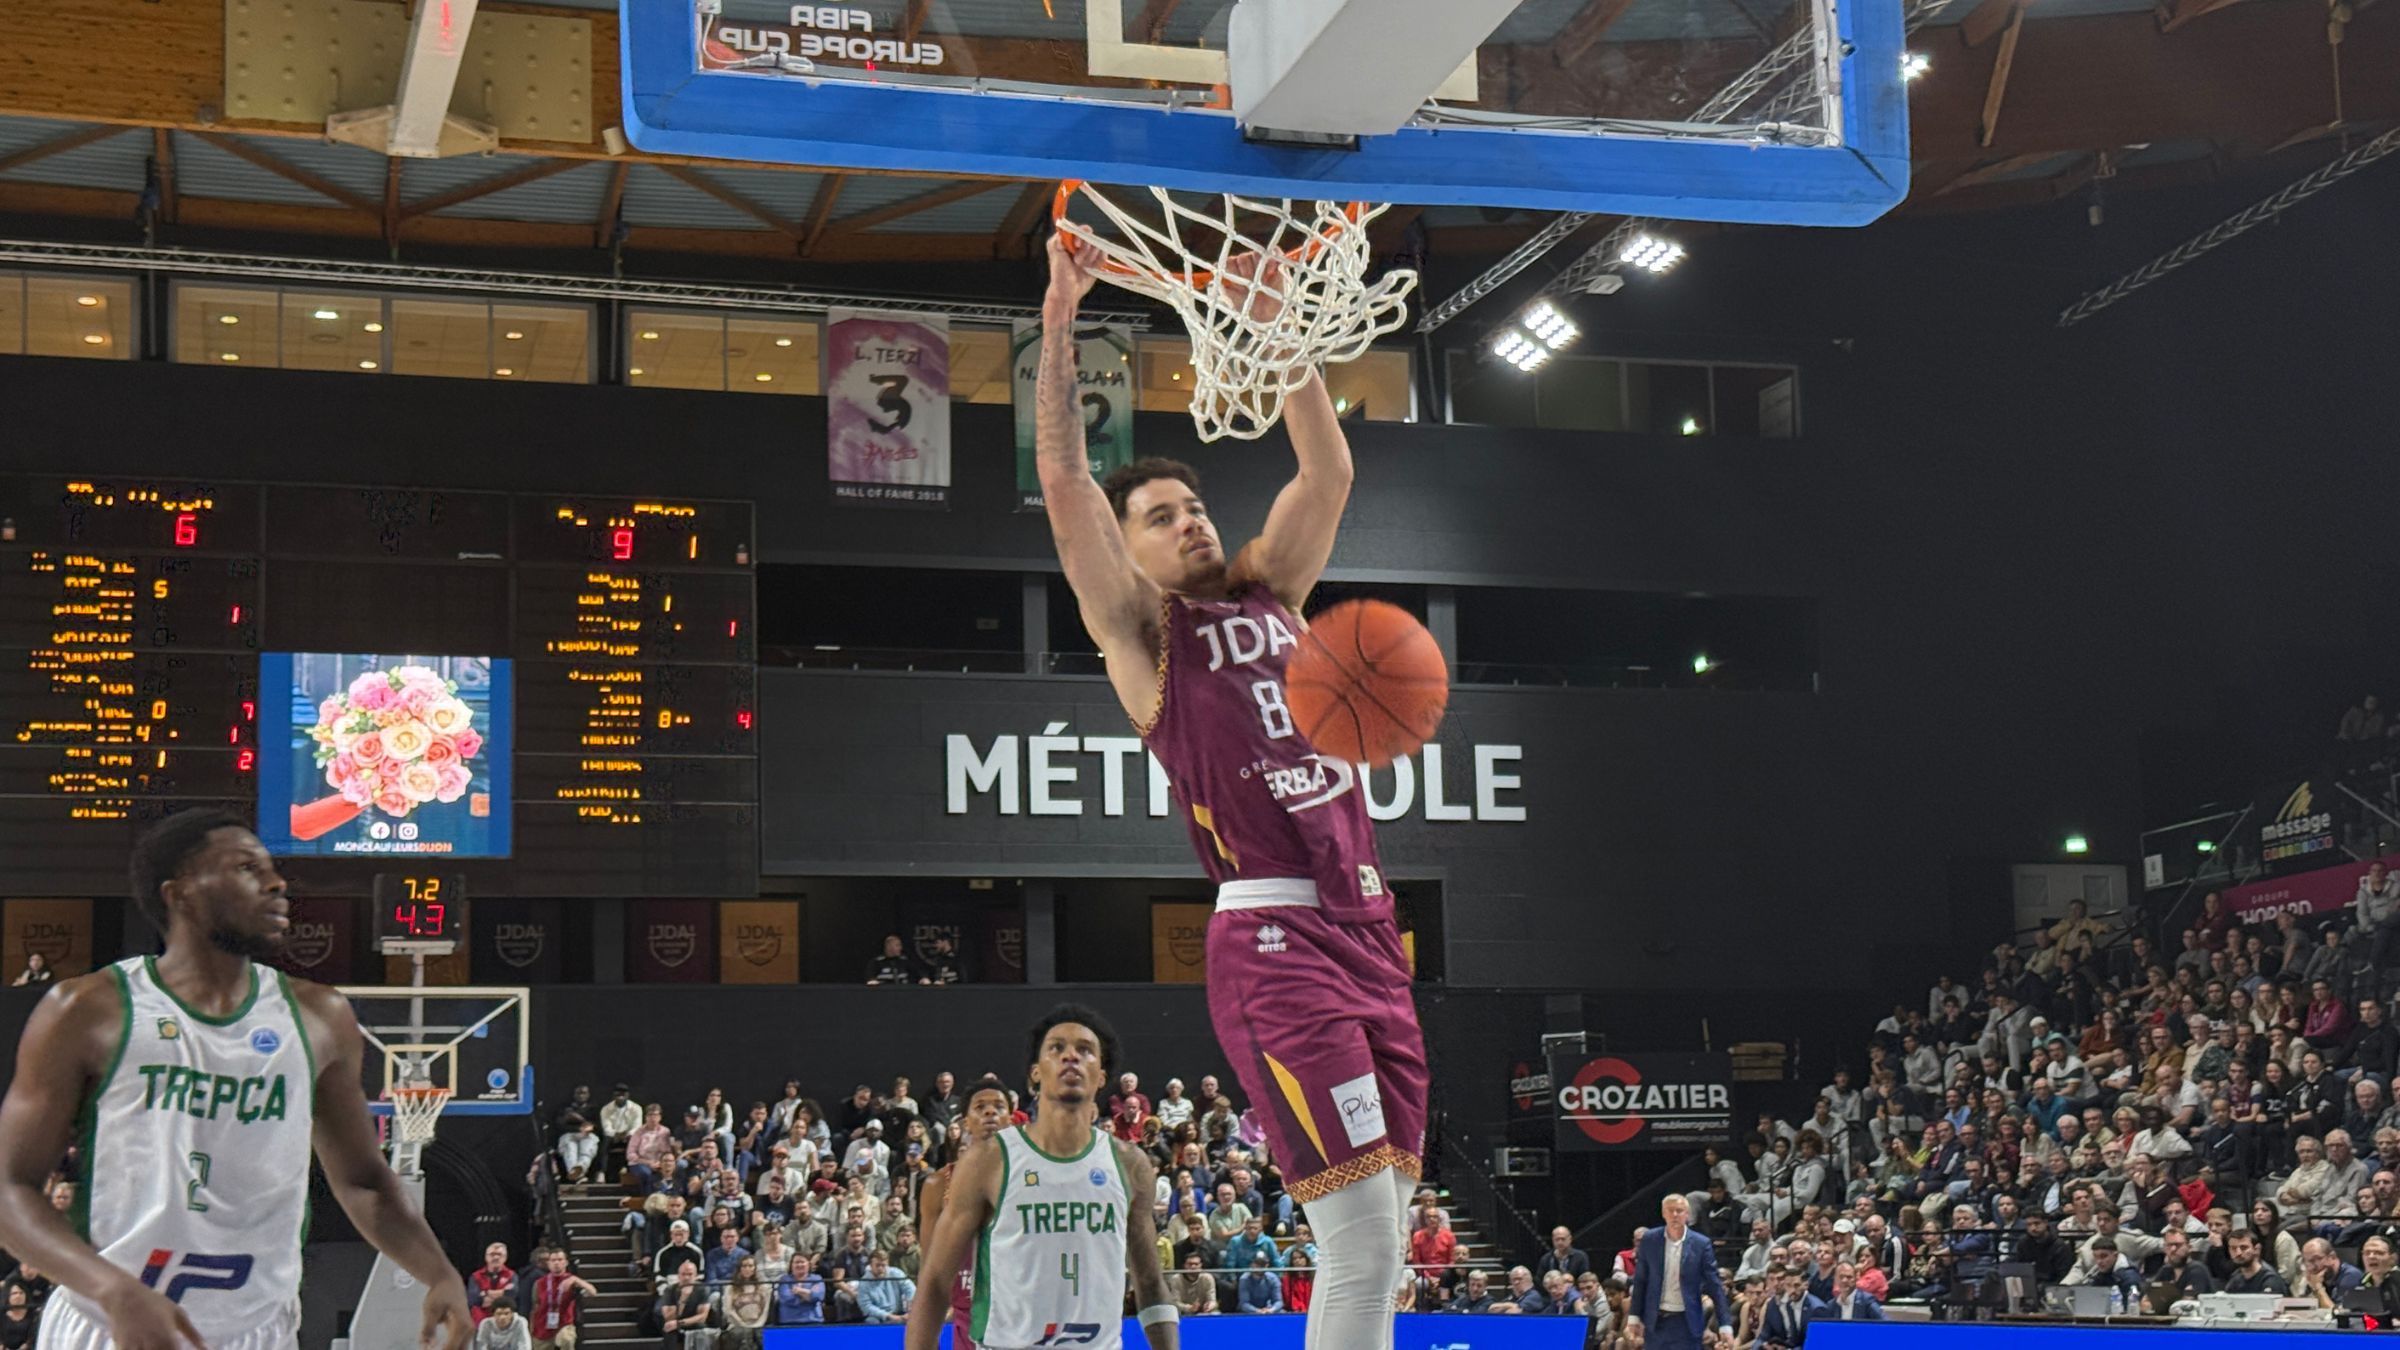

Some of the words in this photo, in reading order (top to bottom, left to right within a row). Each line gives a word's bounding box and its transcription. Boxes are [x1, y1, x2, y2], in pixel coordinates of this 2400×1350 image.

[876, 348, 921, 366] TERZI
[868, 374, 912, 435] 3
[836, 487, 864, 498] HALL
[867, 488, 882, 498] OF
[885, 490, 914, 499] FAME
[175, 514, 197, 545] 6
[614, 531, 633, 559] 9
[154, 579, 168, 599] 5
[1196, 614, 1298, 672] JDA
[1251, 680, 1294, 740] 8
[946, 722, 1527, 822] MÉTOLE
[2262, 812, 2332, 842] message
[404, 878, 440, 901] 7.2
[2252, 890, 2290, 904] GROUPE
[395, 904, 445, 935] 4.3
[139, 1064, 286, 1125] TREPÇA
[1559, 1084, 1730, 1110] CROZATIER
[187, 1151, 211, 1212] 2
[1016, 1202, 1116, 1235] TREPÇA
[1061, 1253, 1079, 1296] 4
